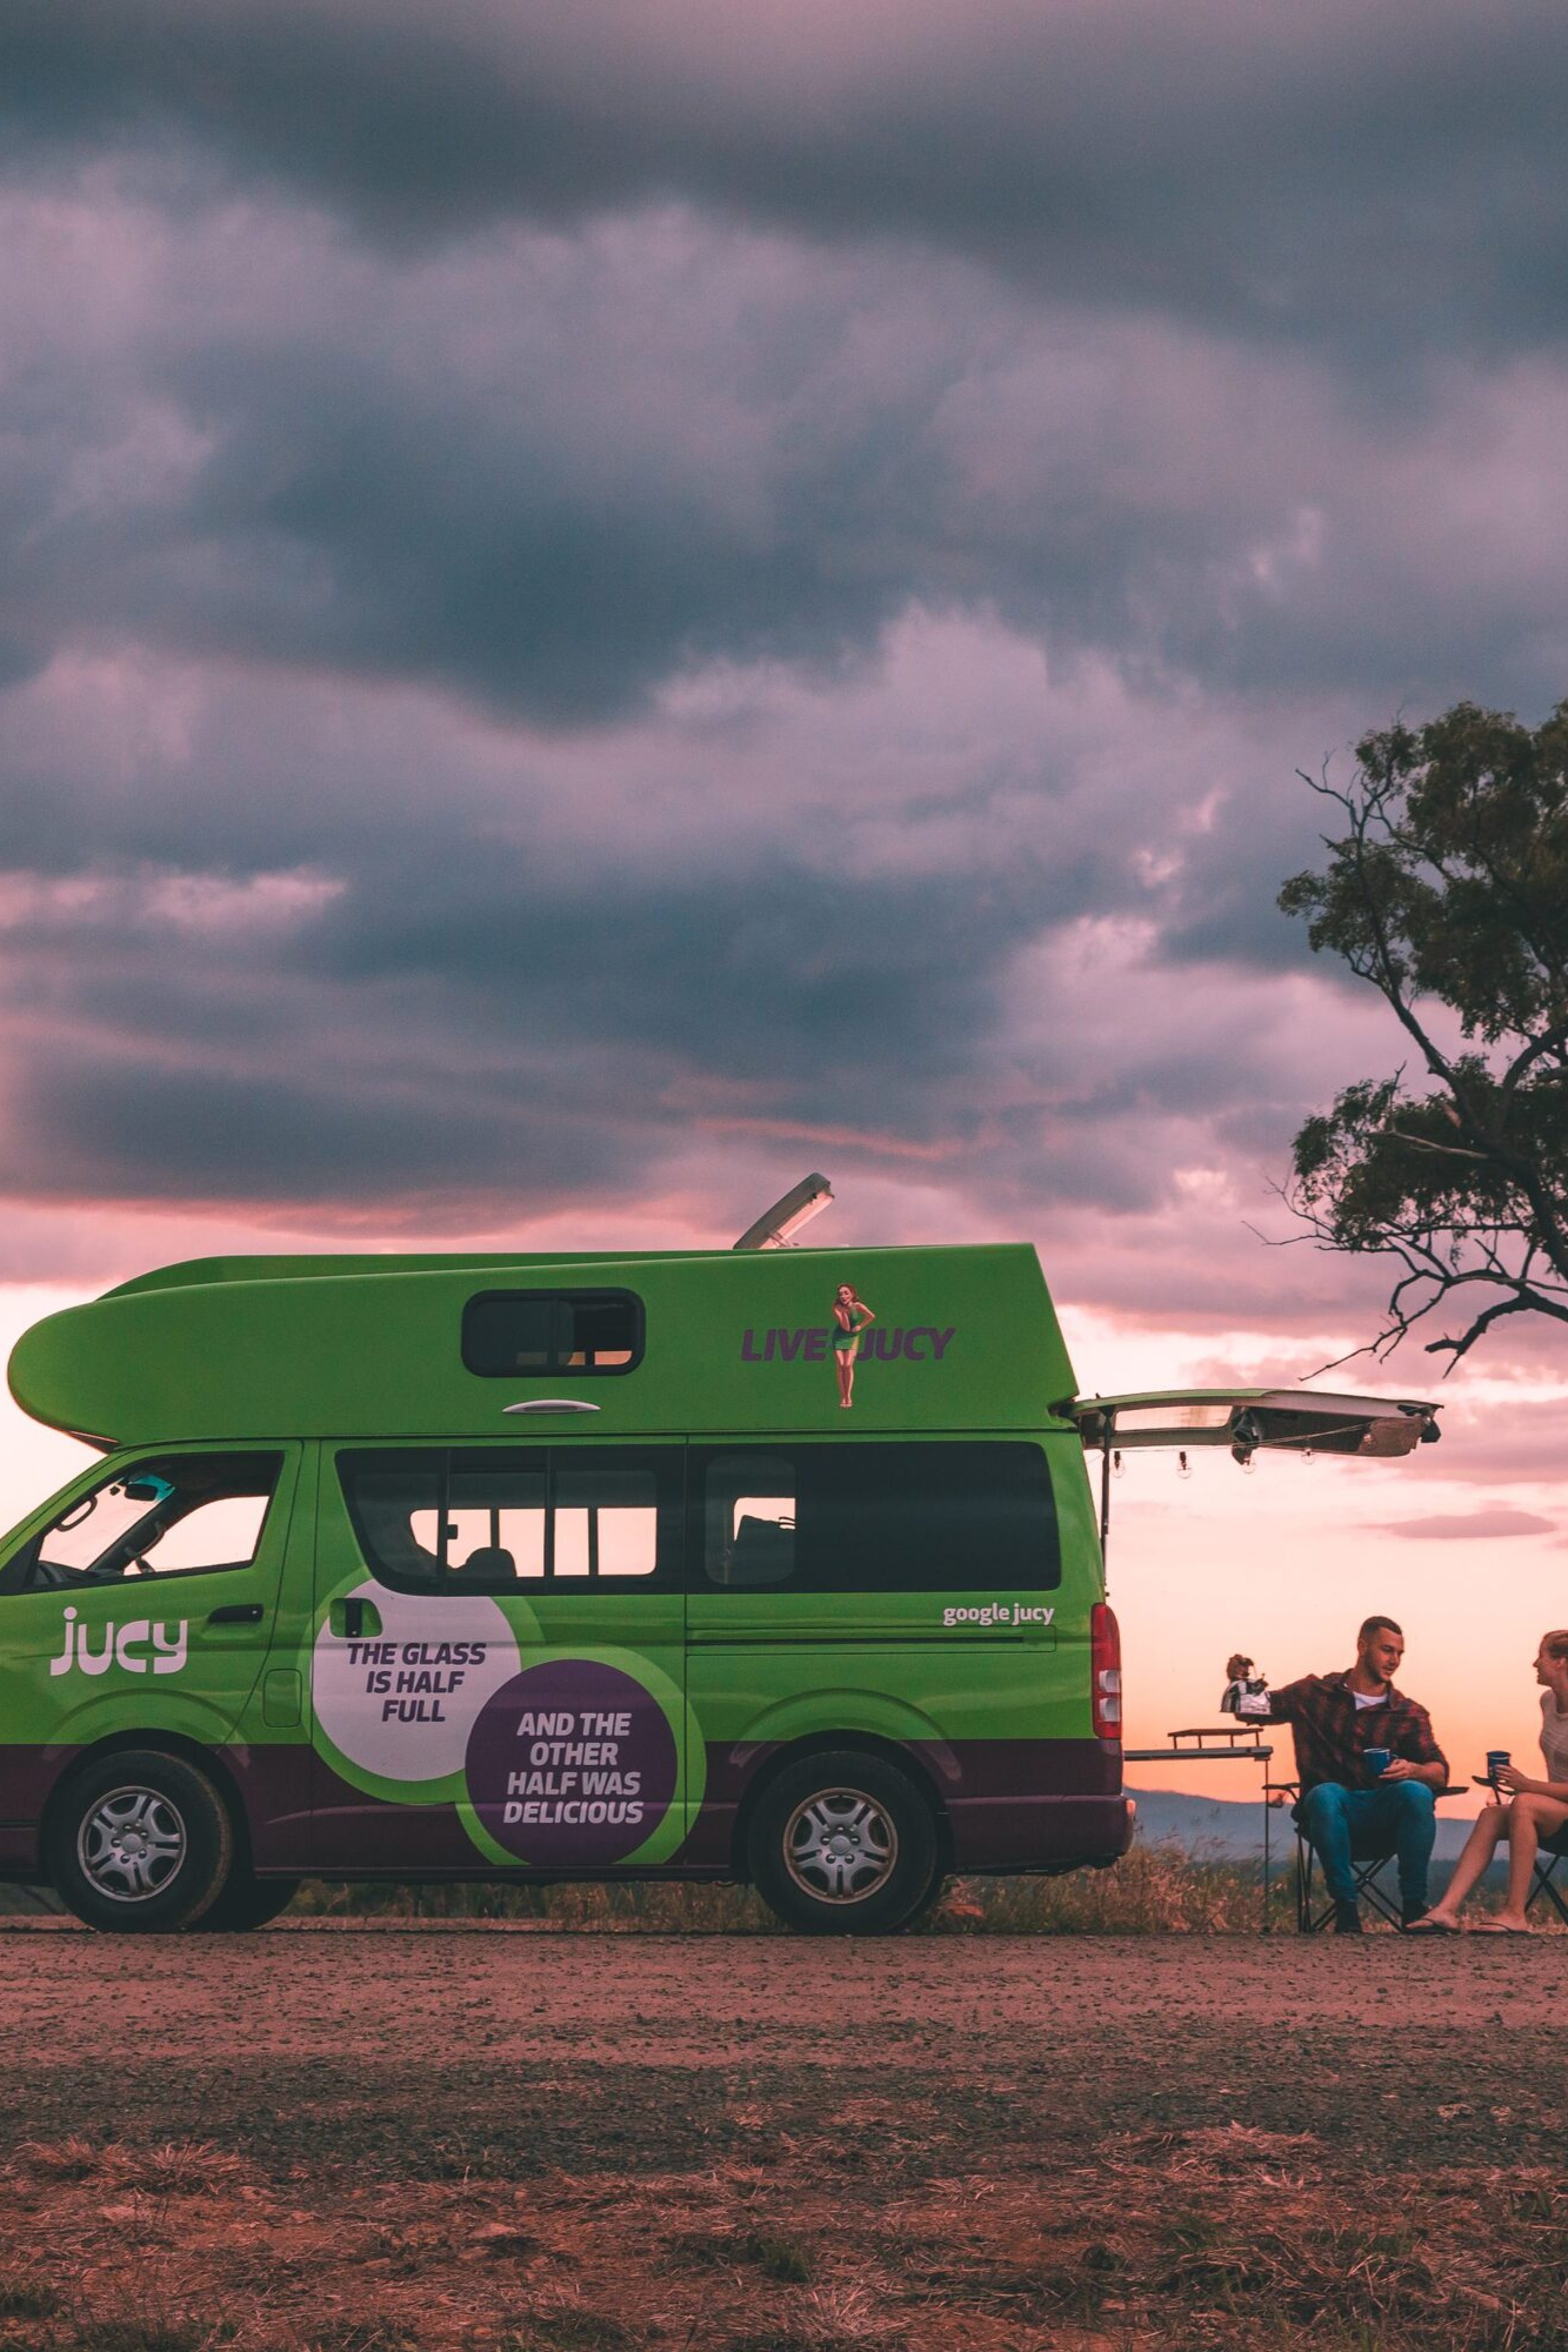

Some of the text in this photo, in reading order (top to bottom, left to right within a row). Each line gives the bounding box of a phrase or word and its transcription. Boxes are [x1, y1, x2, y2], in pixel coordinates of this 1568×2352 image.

[742, 1327, 955, 1361] LIVE JUCY
[943, 1602, 1055, 1626] google jucy
[50, 1606, 188, 1676] jucy
[348, 1642, 486, 1665] THE GLASS
[366, 1671, 465, 1693] IS HALF
[382, 1700, 446, 1722] FULL
[517, 1713, 632, 1736] AND THE
[530, 1742, 619, 1765] OTHER
[507, 1771, 641, 1795] HALF WAS
[503, 1801, 644, 1824] DELICIOUS
